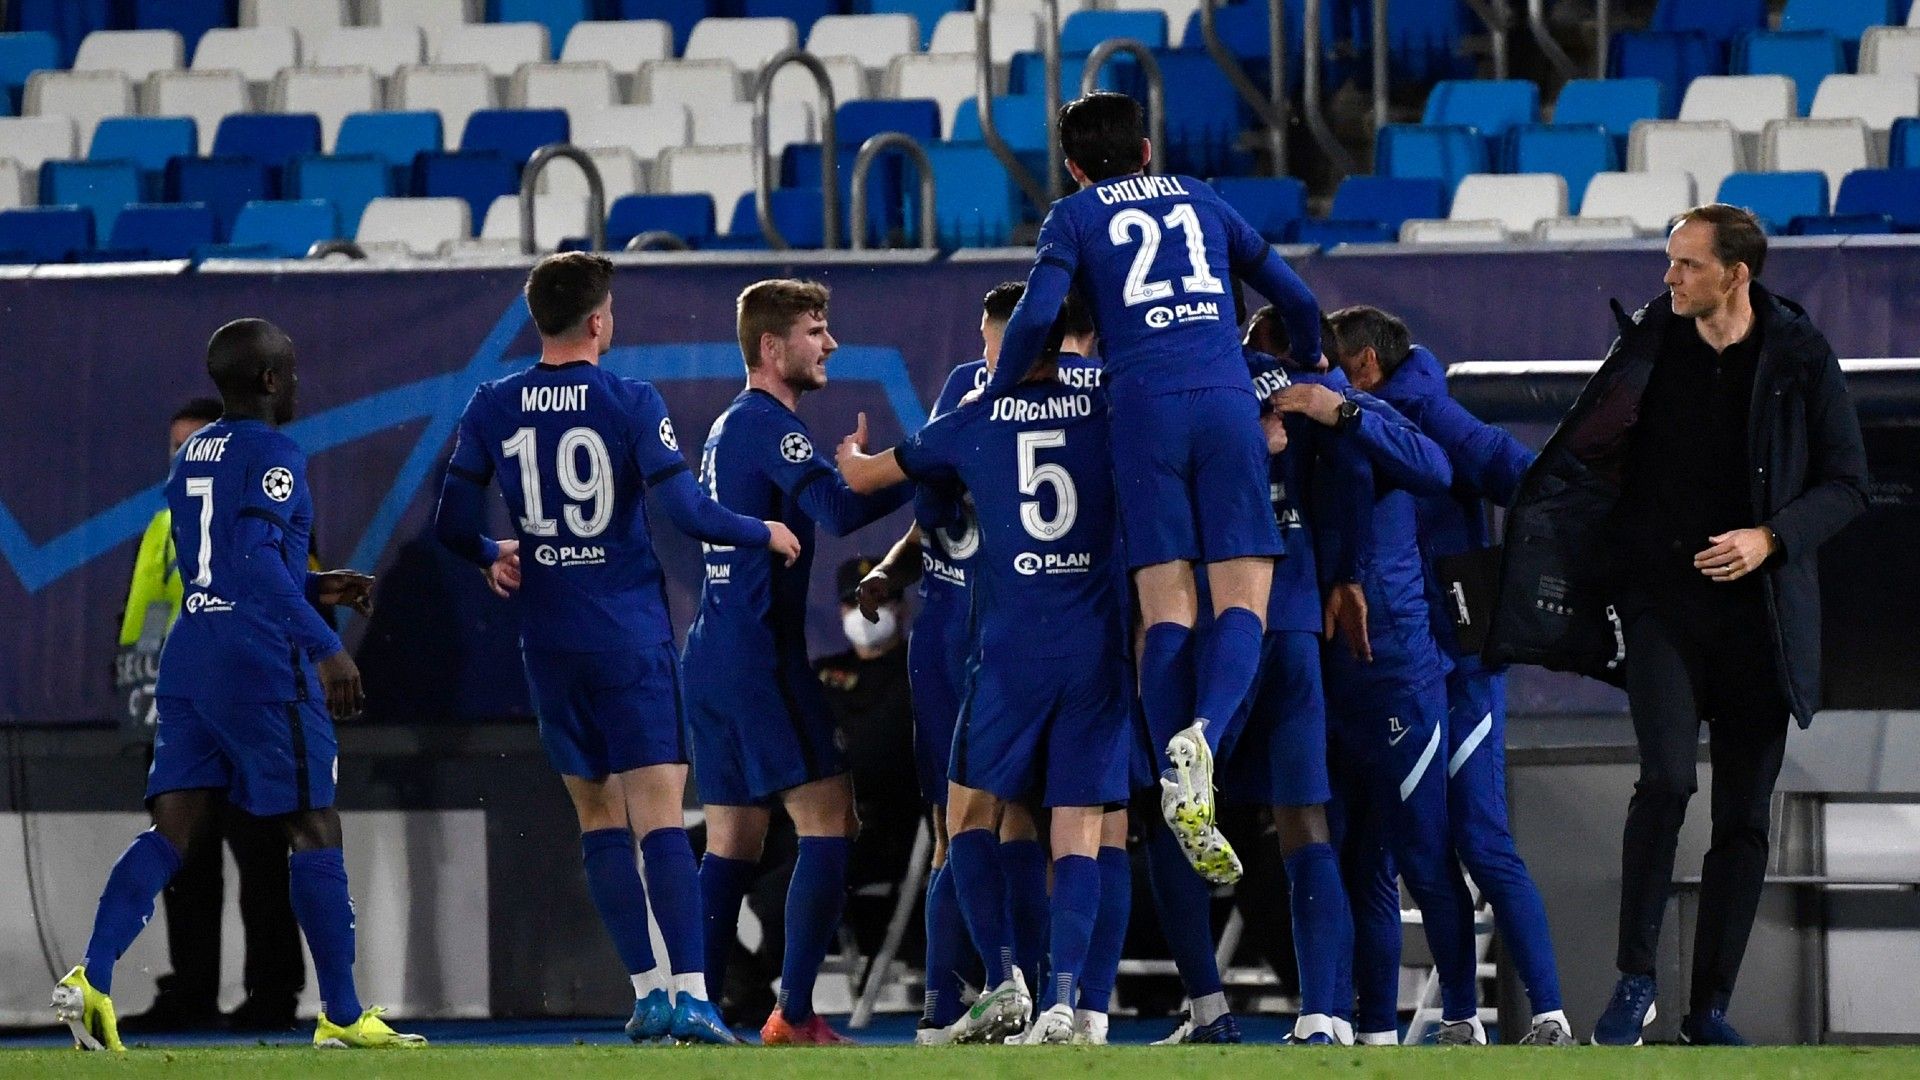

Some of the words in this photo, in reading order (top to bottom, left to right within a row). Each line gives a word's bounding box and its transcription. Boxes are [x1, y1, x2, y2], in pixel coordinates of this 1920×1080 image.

[1096, 176, 1189, 205] CHILWELL
[1108, 203, 1225, 307] 21
[1175, 302, 1219, 318] PLAN
[521, 385, 589, 412] MOUNT
[990, 394, 1092, 422] JORGINHO
[185, 432, 232, 463] KANTÉ
[502, 426, 616, 538] 19
[1017, 428, 1079, 542] 5
[185, 476, 215, 588] 7
[560, 545, 606, 560] PLAN
[1045, 553, 1091, 568] PLAN
[711, 563, 731, 578] PLAN
[934, 559, 965, 581] PLAN
[1388, 716, 1404, 732] ZL
